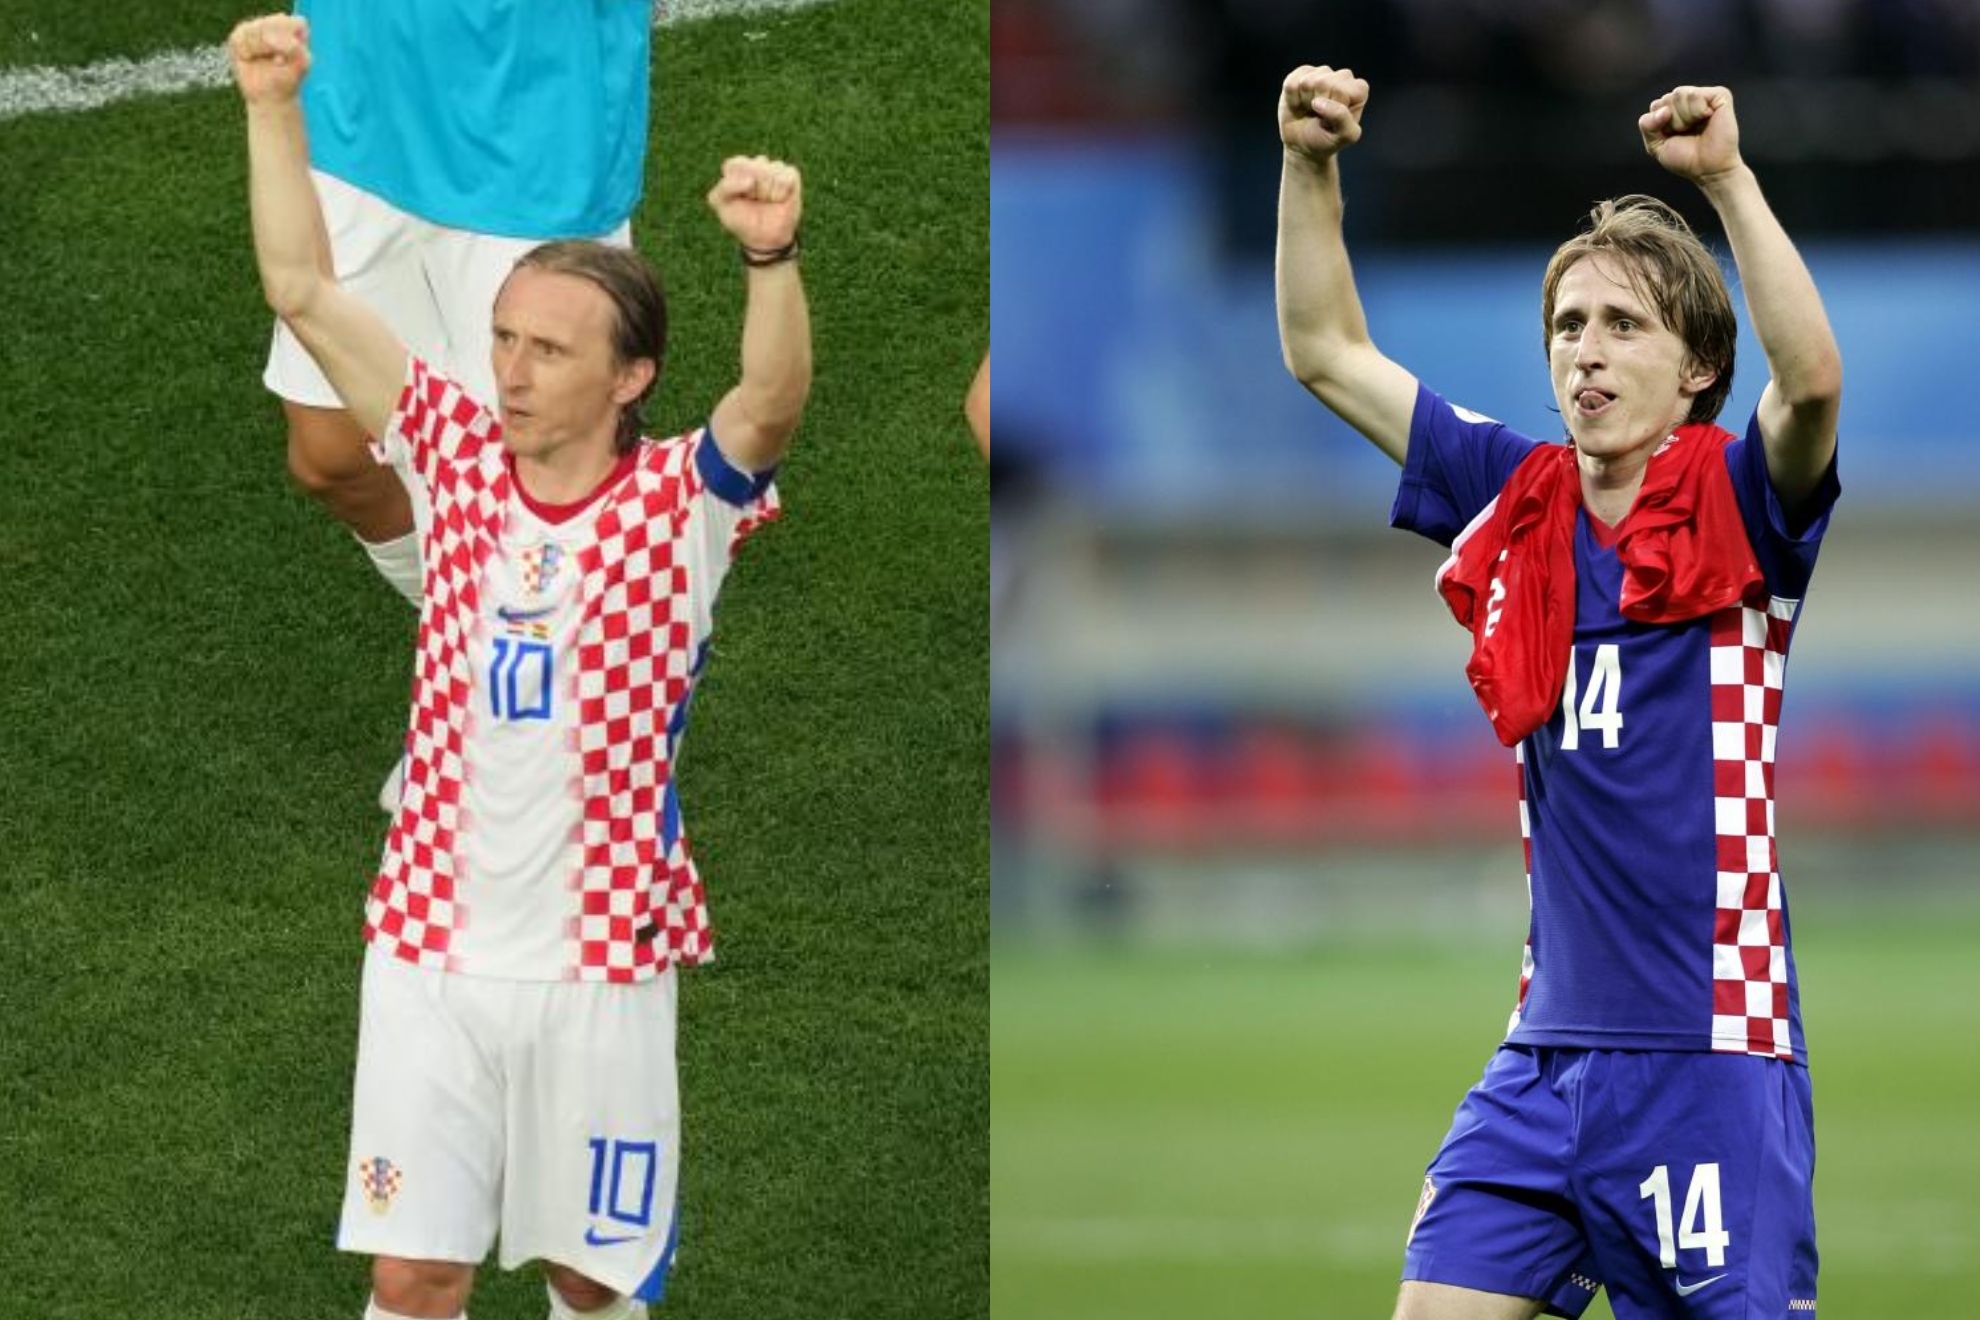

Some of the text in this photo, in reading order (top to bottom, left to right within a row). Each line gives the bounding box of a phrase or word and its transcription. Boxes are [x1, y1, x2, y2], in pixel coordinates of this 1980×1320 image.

[490, 637, 554, 721] 10
[1561, 643, 1623, 750] 14
[589, 1138, 657, 1227] 10
[1639, 1162, 1730, 1269] 14
